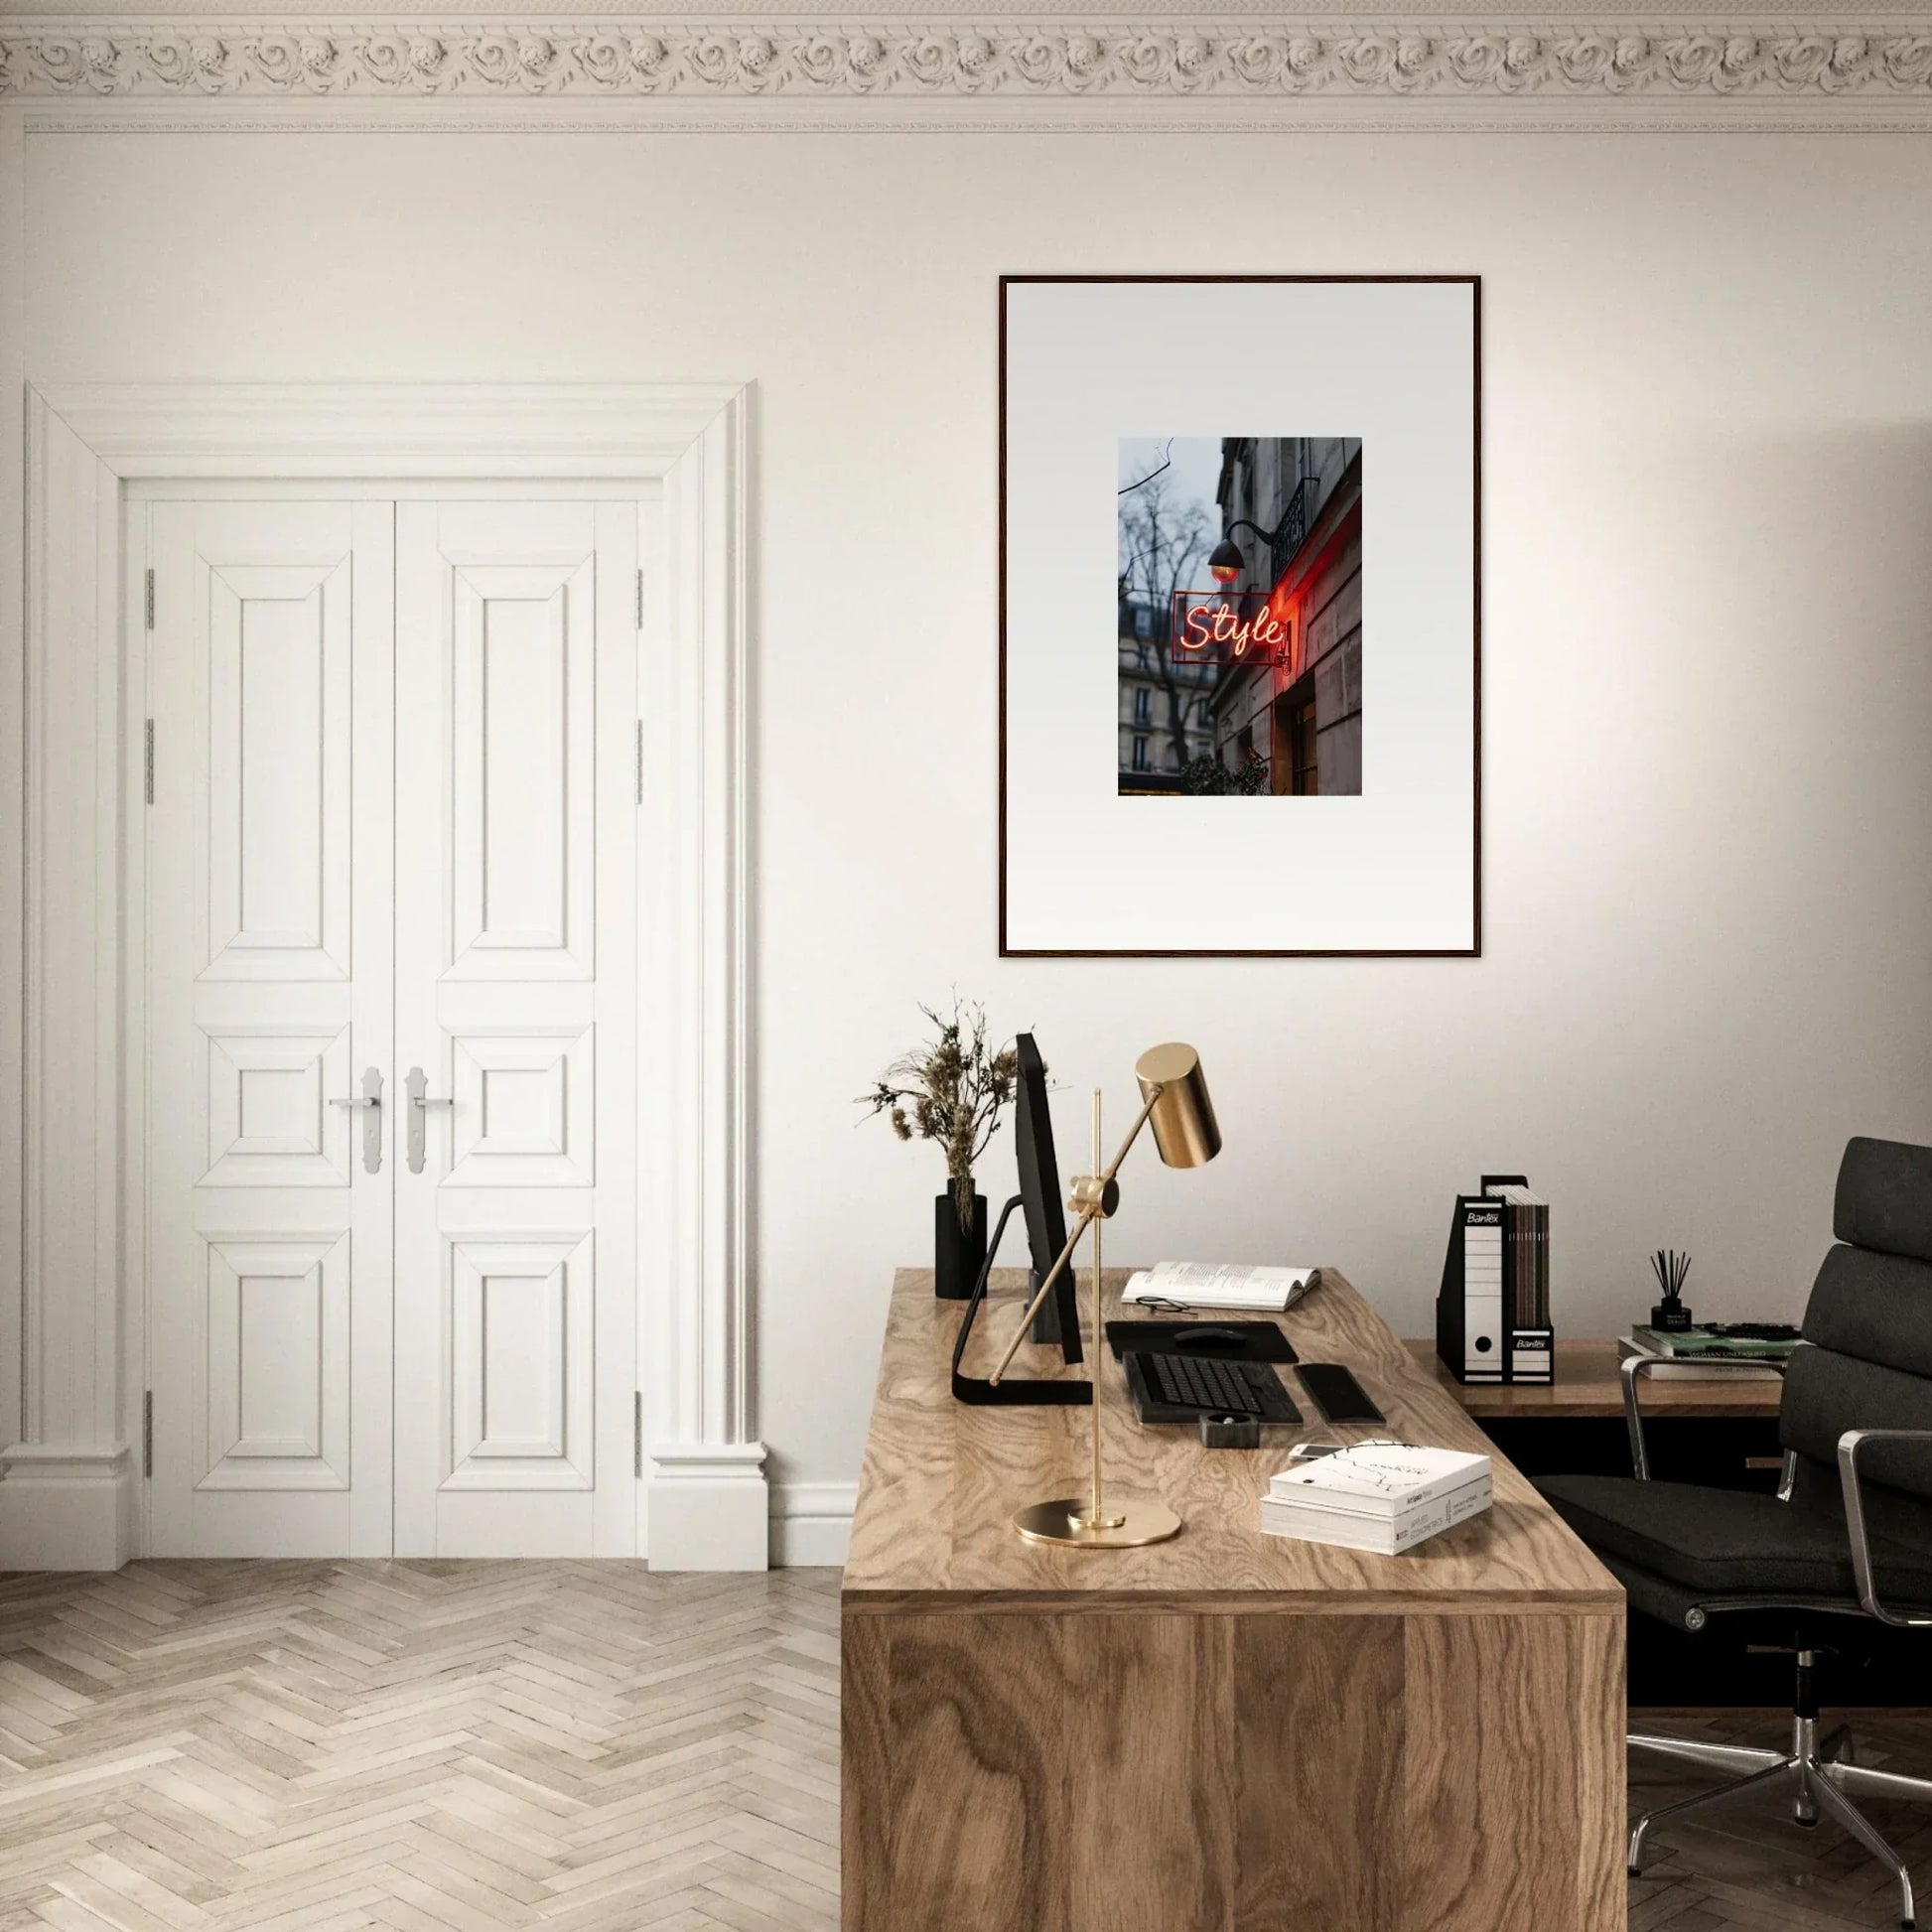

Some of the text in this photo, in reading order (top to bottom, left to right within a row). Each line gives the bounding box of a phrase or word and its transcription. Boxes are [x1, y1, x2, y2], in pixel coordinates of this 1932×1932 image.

[1180, 603, 1285, 656] Style
[1466, 1212, 1499, 1224] Bantex
[1516, 1339, 1545, 1348] Bantex
